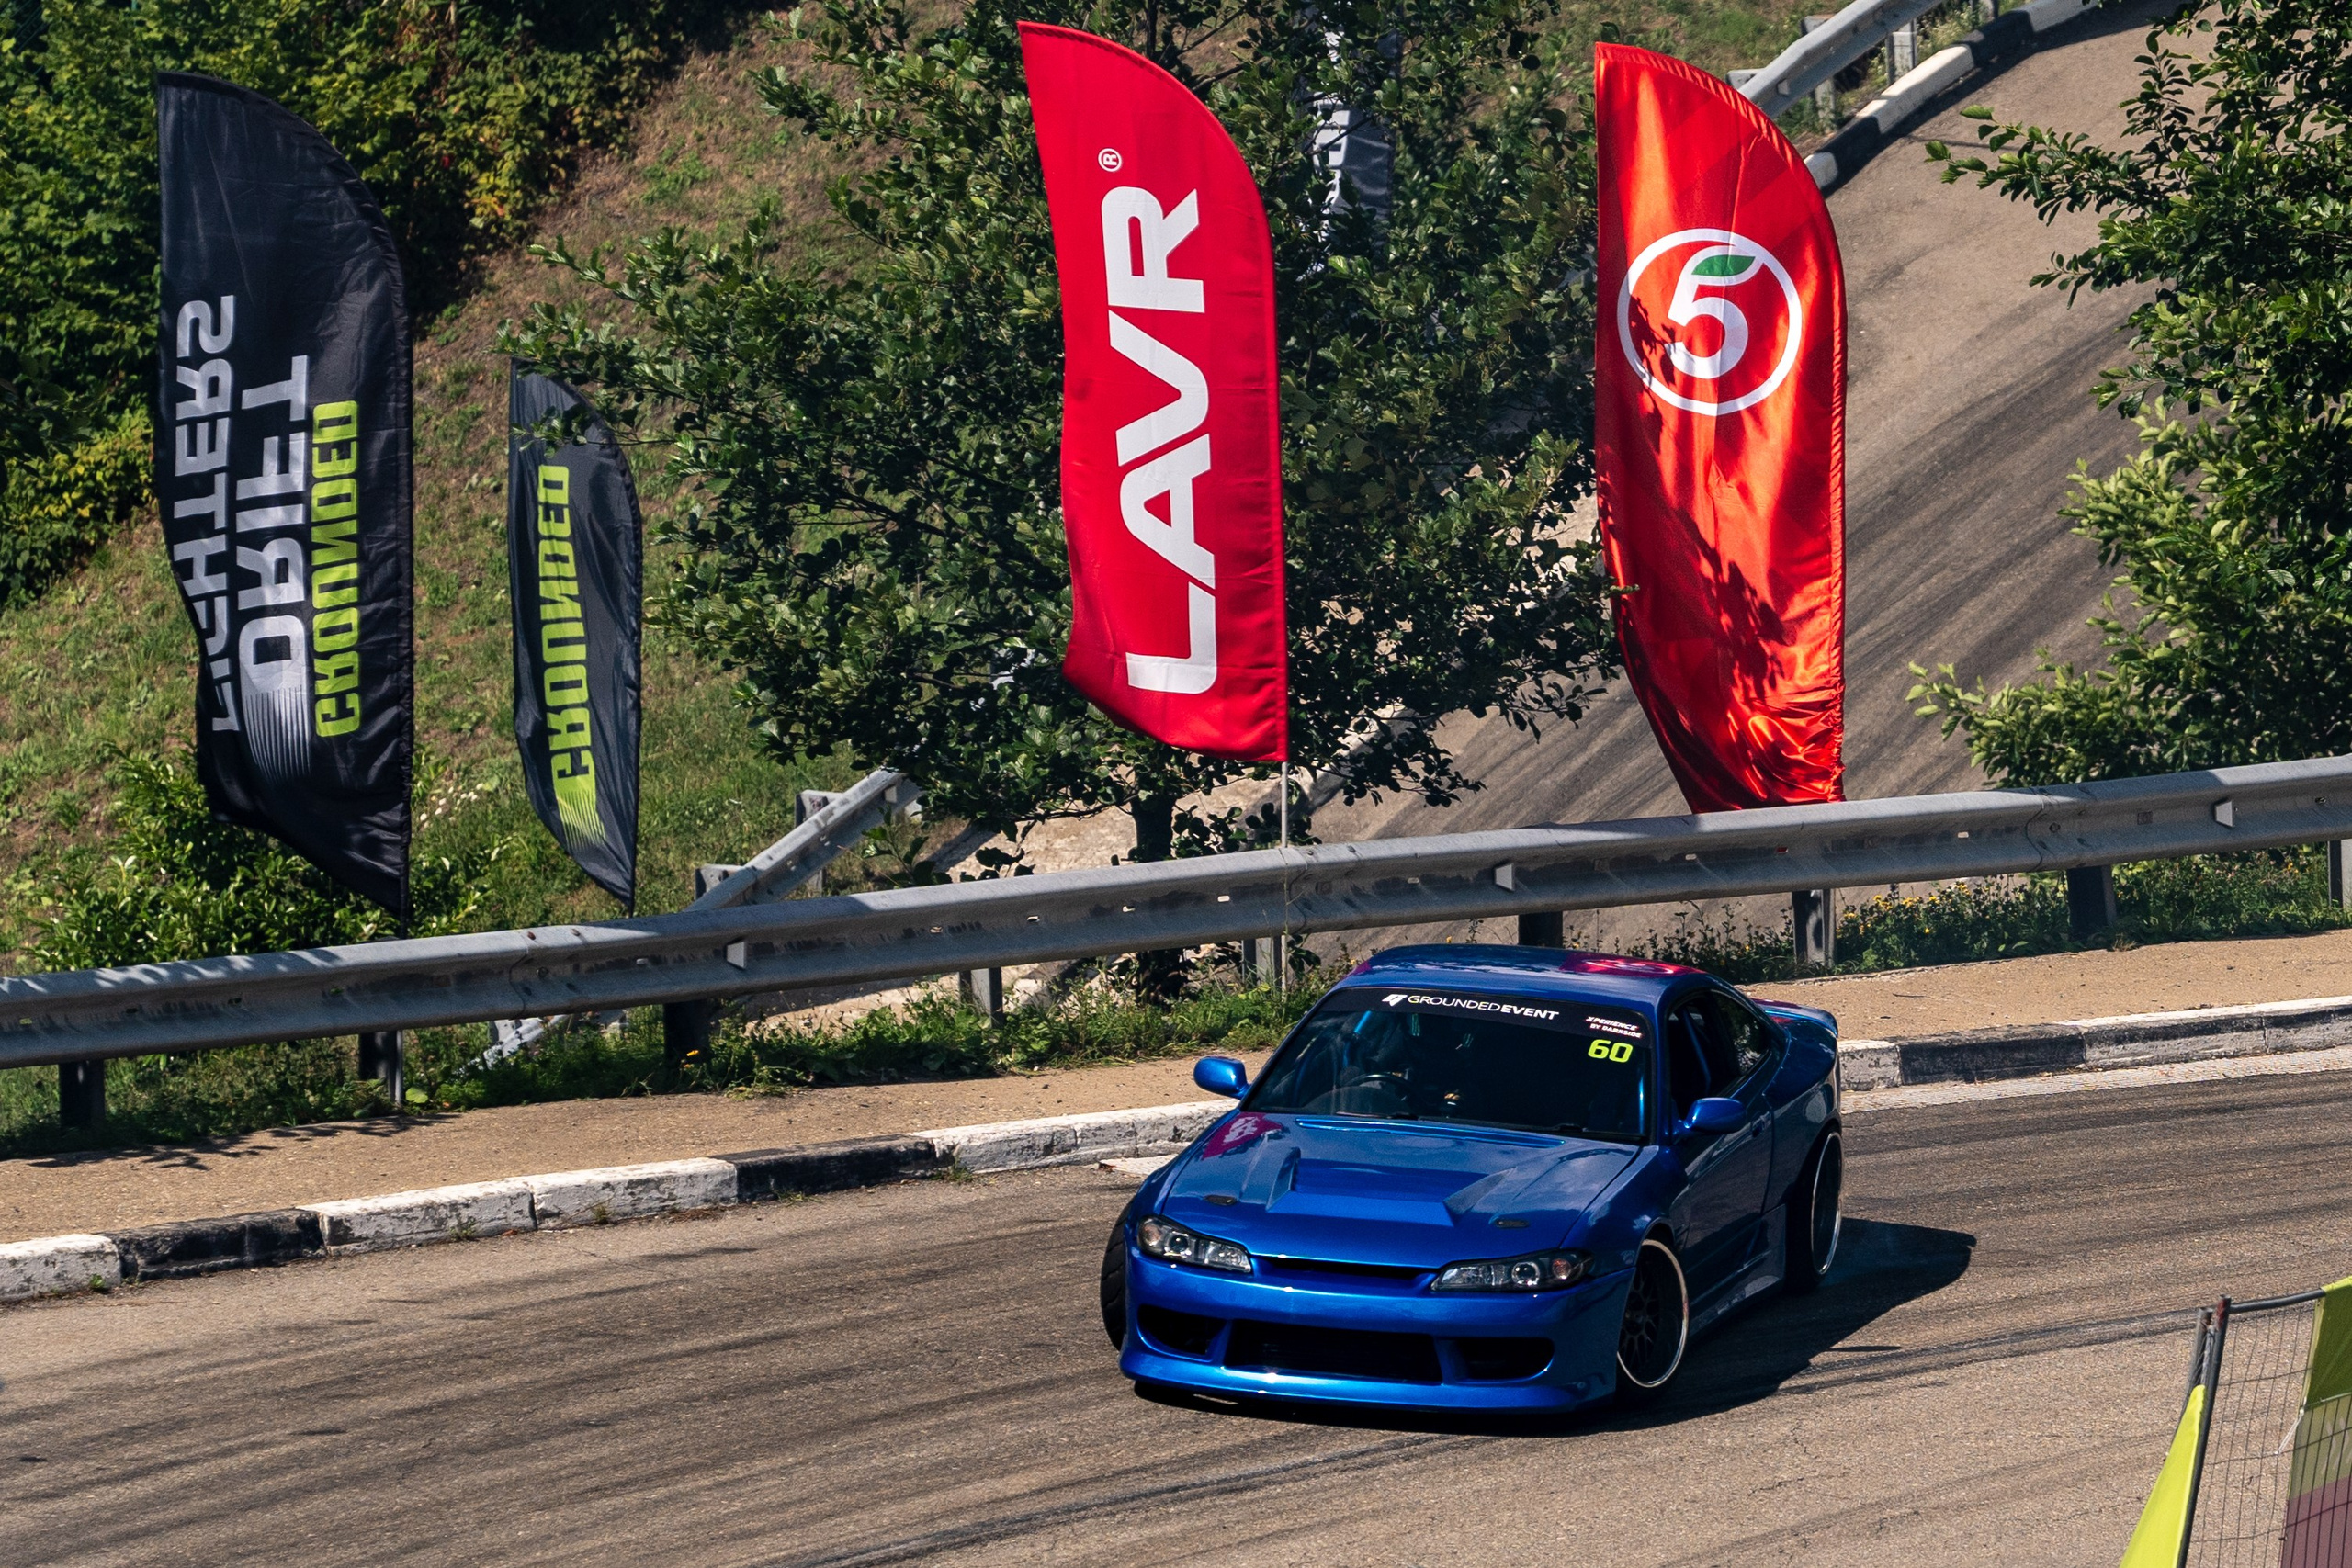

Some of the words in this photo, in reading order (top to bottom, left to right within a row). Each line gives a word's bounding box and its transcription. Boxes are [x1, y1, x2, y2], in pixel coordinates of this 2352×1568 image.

[1408, 995, 1559, 1020] GROUNDEDEVENT
[1585, 1016, 1638, 1031] XPERIENCE
[1601, 1025, 1643, 1039] DARKSIDE
[1588, 1039, 1633, 1063] 60
